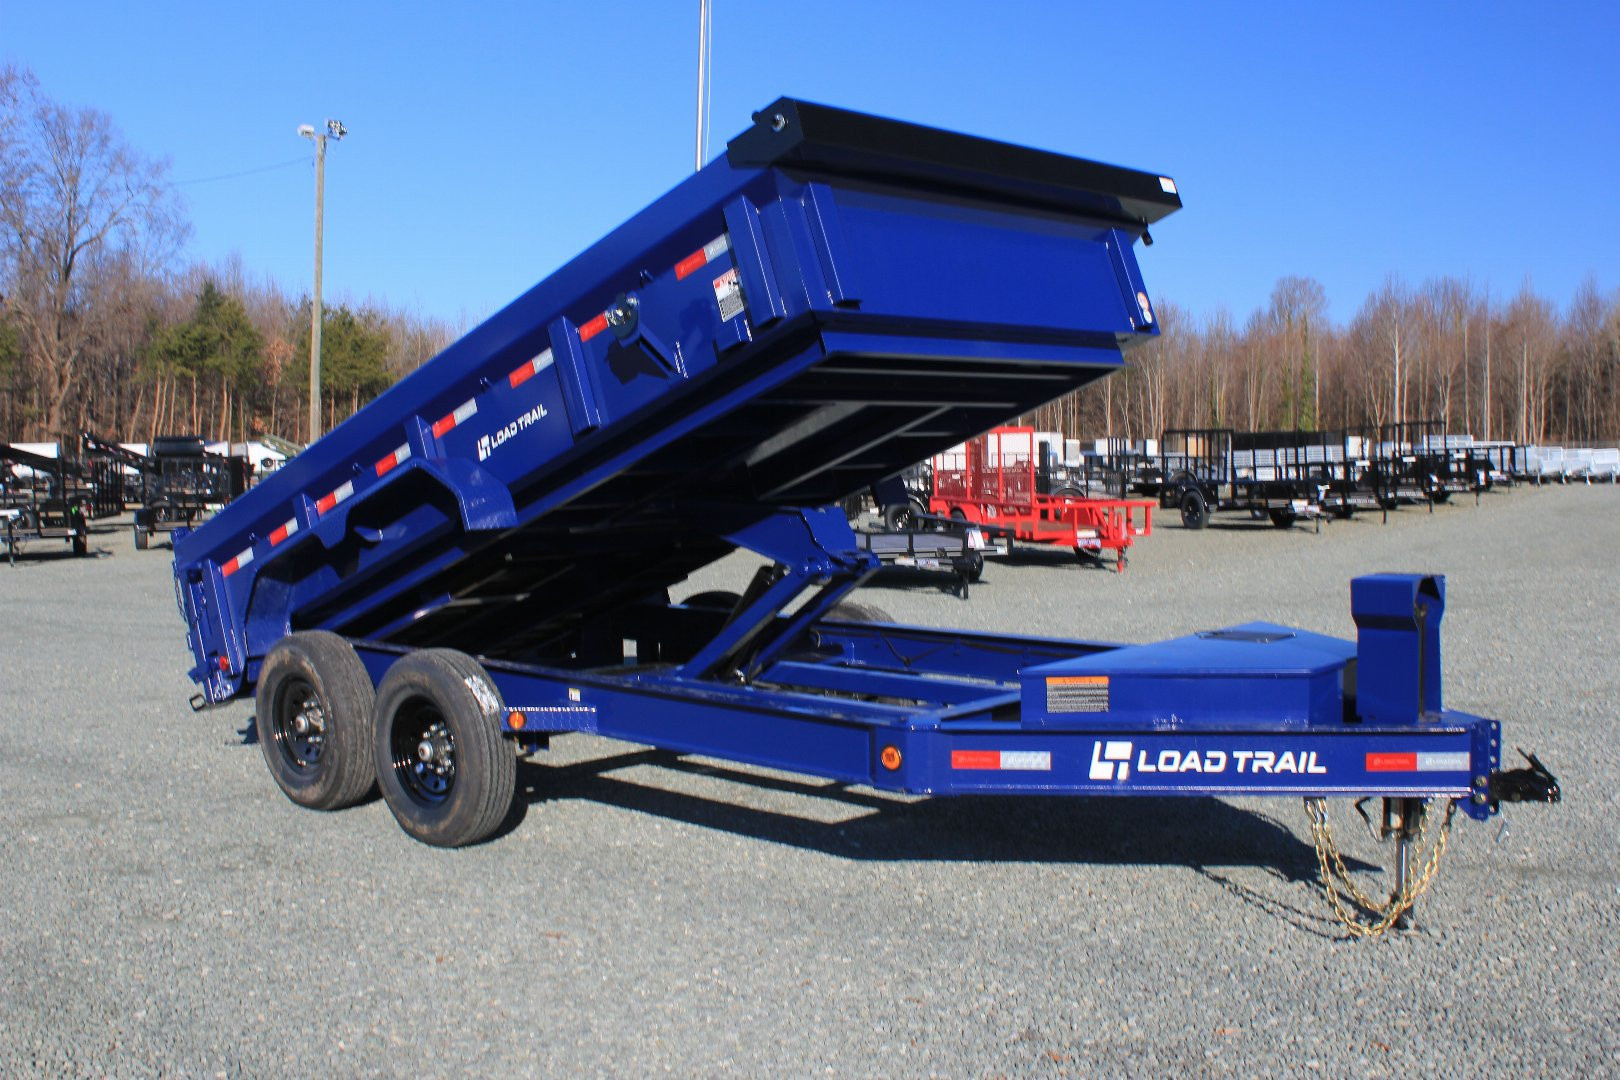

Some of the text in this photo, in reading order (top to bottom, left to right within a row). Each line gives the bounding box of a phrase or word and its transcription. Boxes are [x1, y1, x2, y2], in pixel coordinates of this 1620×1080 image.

[491, 421, 517, 449] LOAD
[517, 404, 547, 430] TRAIL
[1137, 750, 1227, 772] LOAD
[1233, 751, 1327, 773] TRAIL
